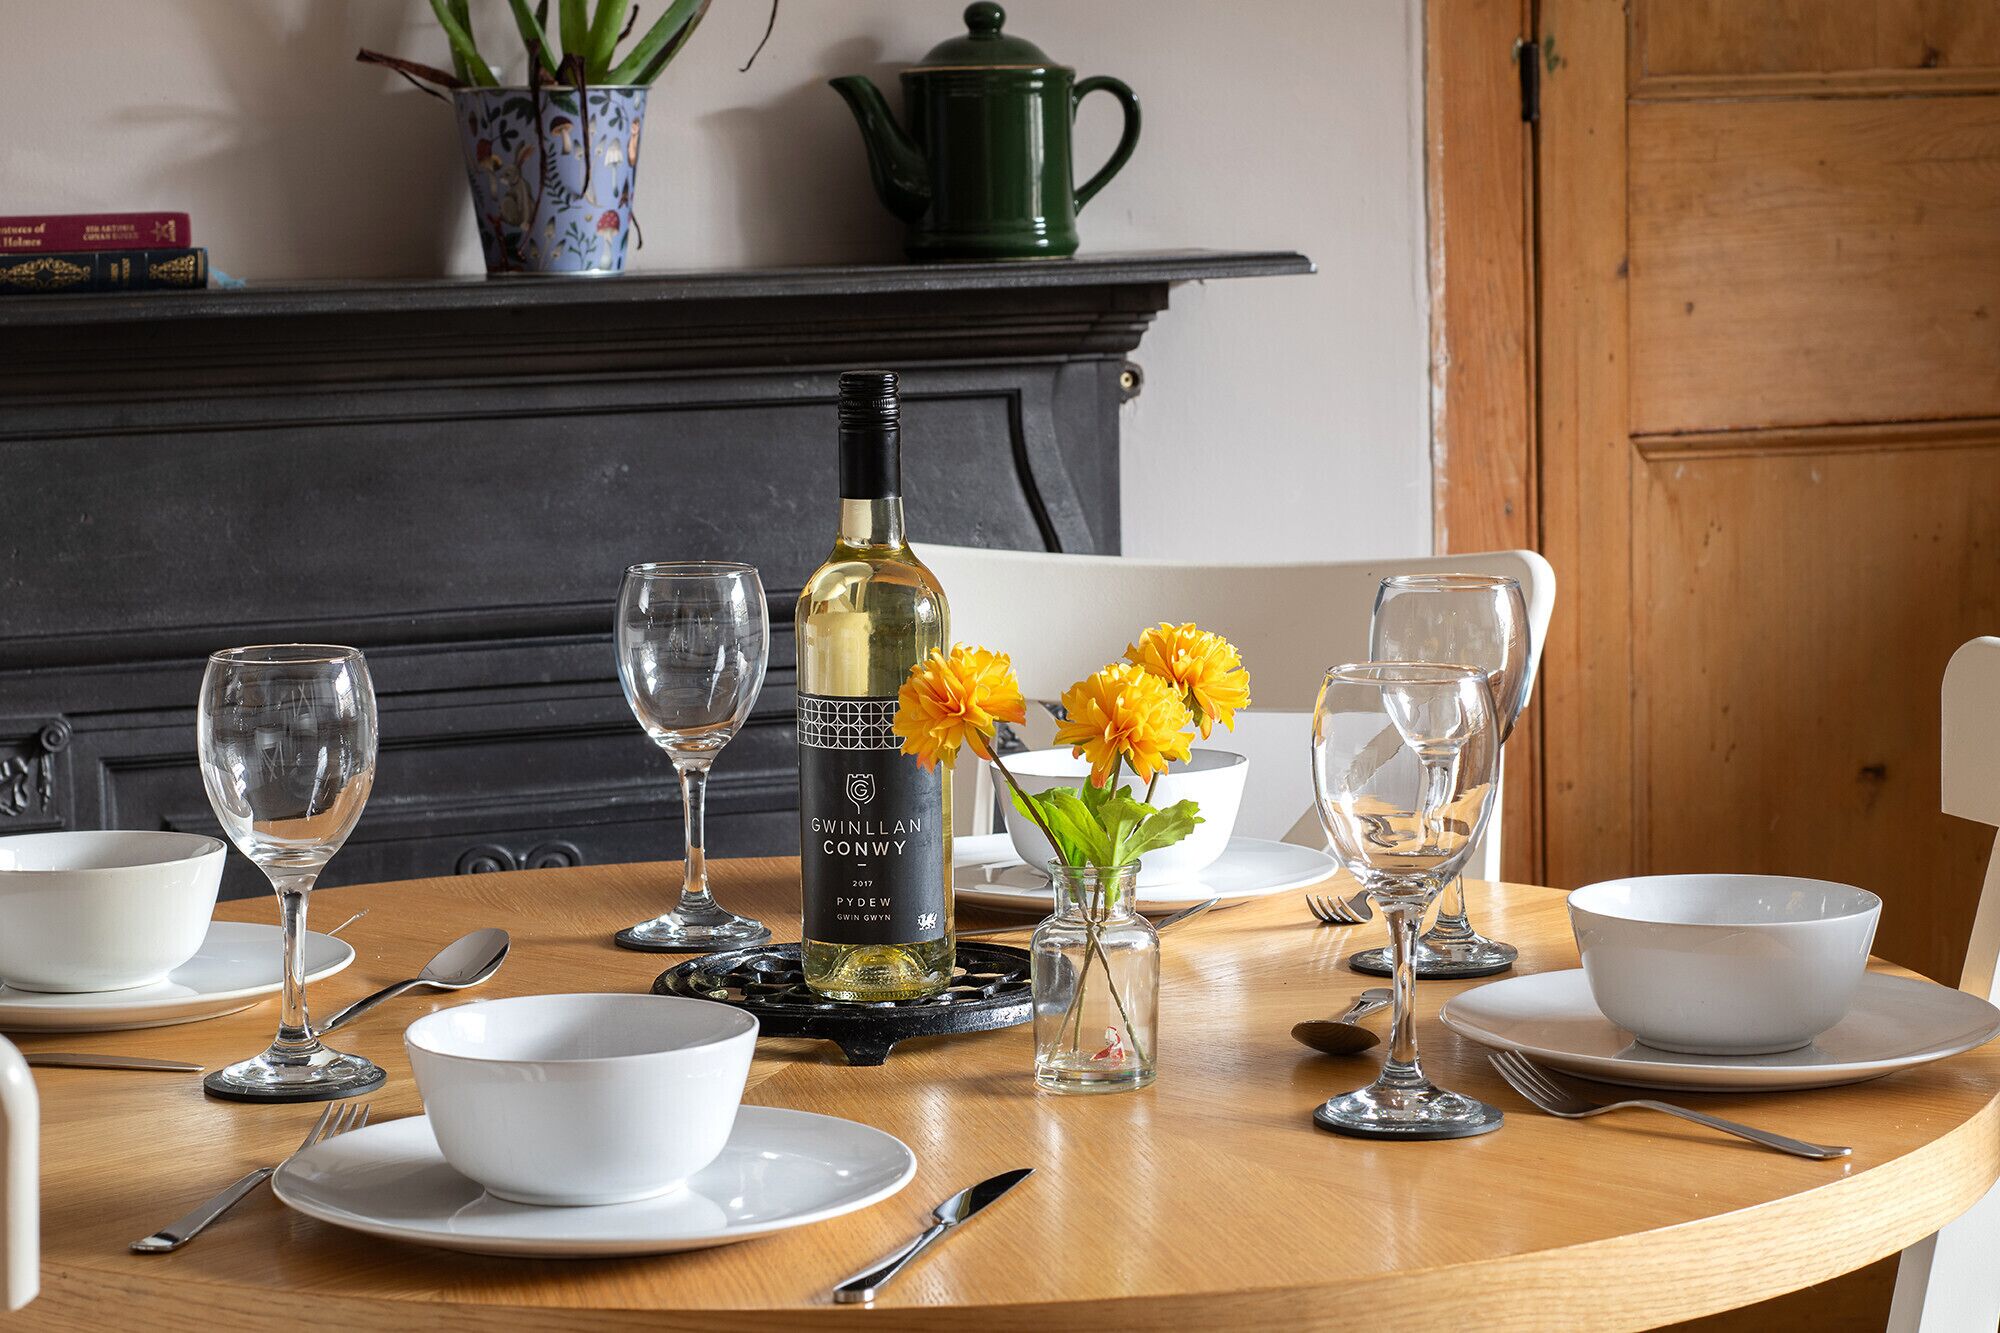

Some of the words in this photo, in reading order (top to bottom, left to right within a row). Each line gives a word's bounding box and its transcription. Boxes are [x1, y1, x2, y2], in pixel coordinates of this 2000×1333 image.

[811, 817, 921, 836] GWINLLAN
[823, 840, 907, 856] CONWY
[852, 880, 873, 888] 2017
[836, 897, 891, 907] PYDEW
[836, 913, 860, 921] GWIN
[863, 914, 891, 922] GWYN
